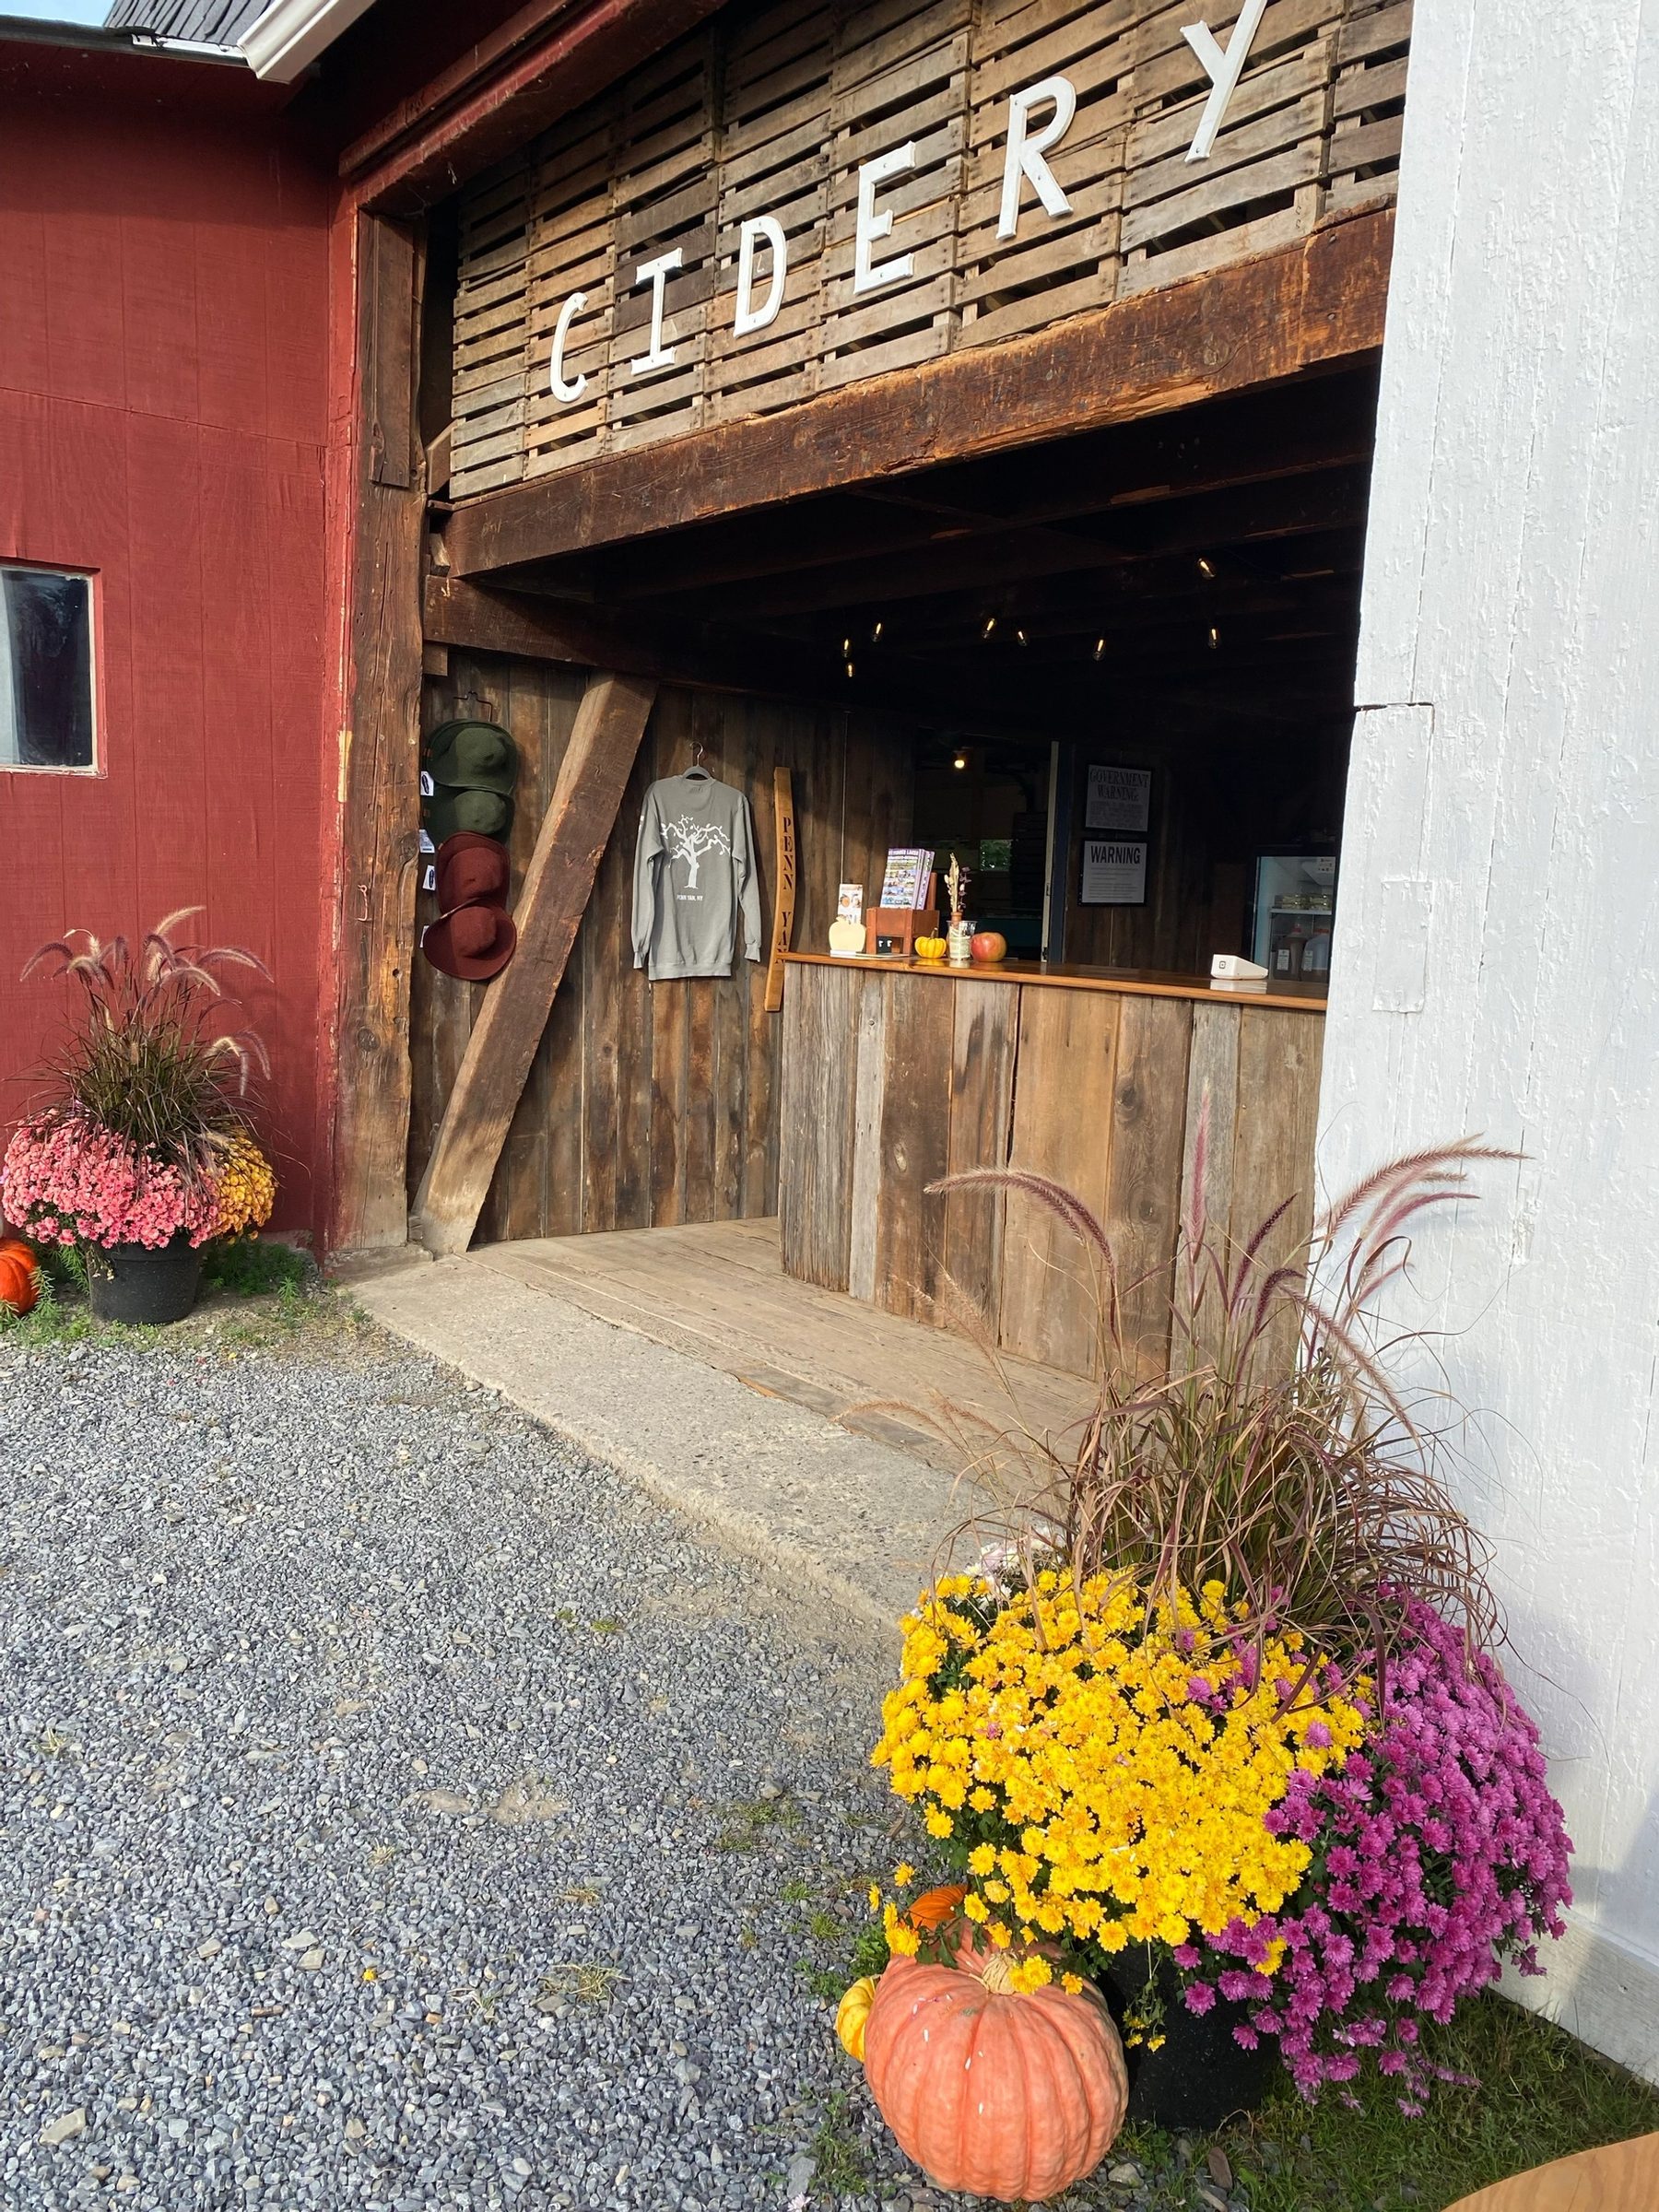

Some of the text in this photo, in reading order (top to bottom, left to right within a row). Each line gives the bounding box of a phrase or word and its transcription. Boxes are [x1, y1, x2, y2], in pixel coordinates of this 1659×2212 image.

[550, 0, 1268, 403] CIDERY
[1090, 769, 1148, 788] GOVERNMENT
[782, 817, 793, 889] PENN
[1090, 845, 1141, 865] WARNING
